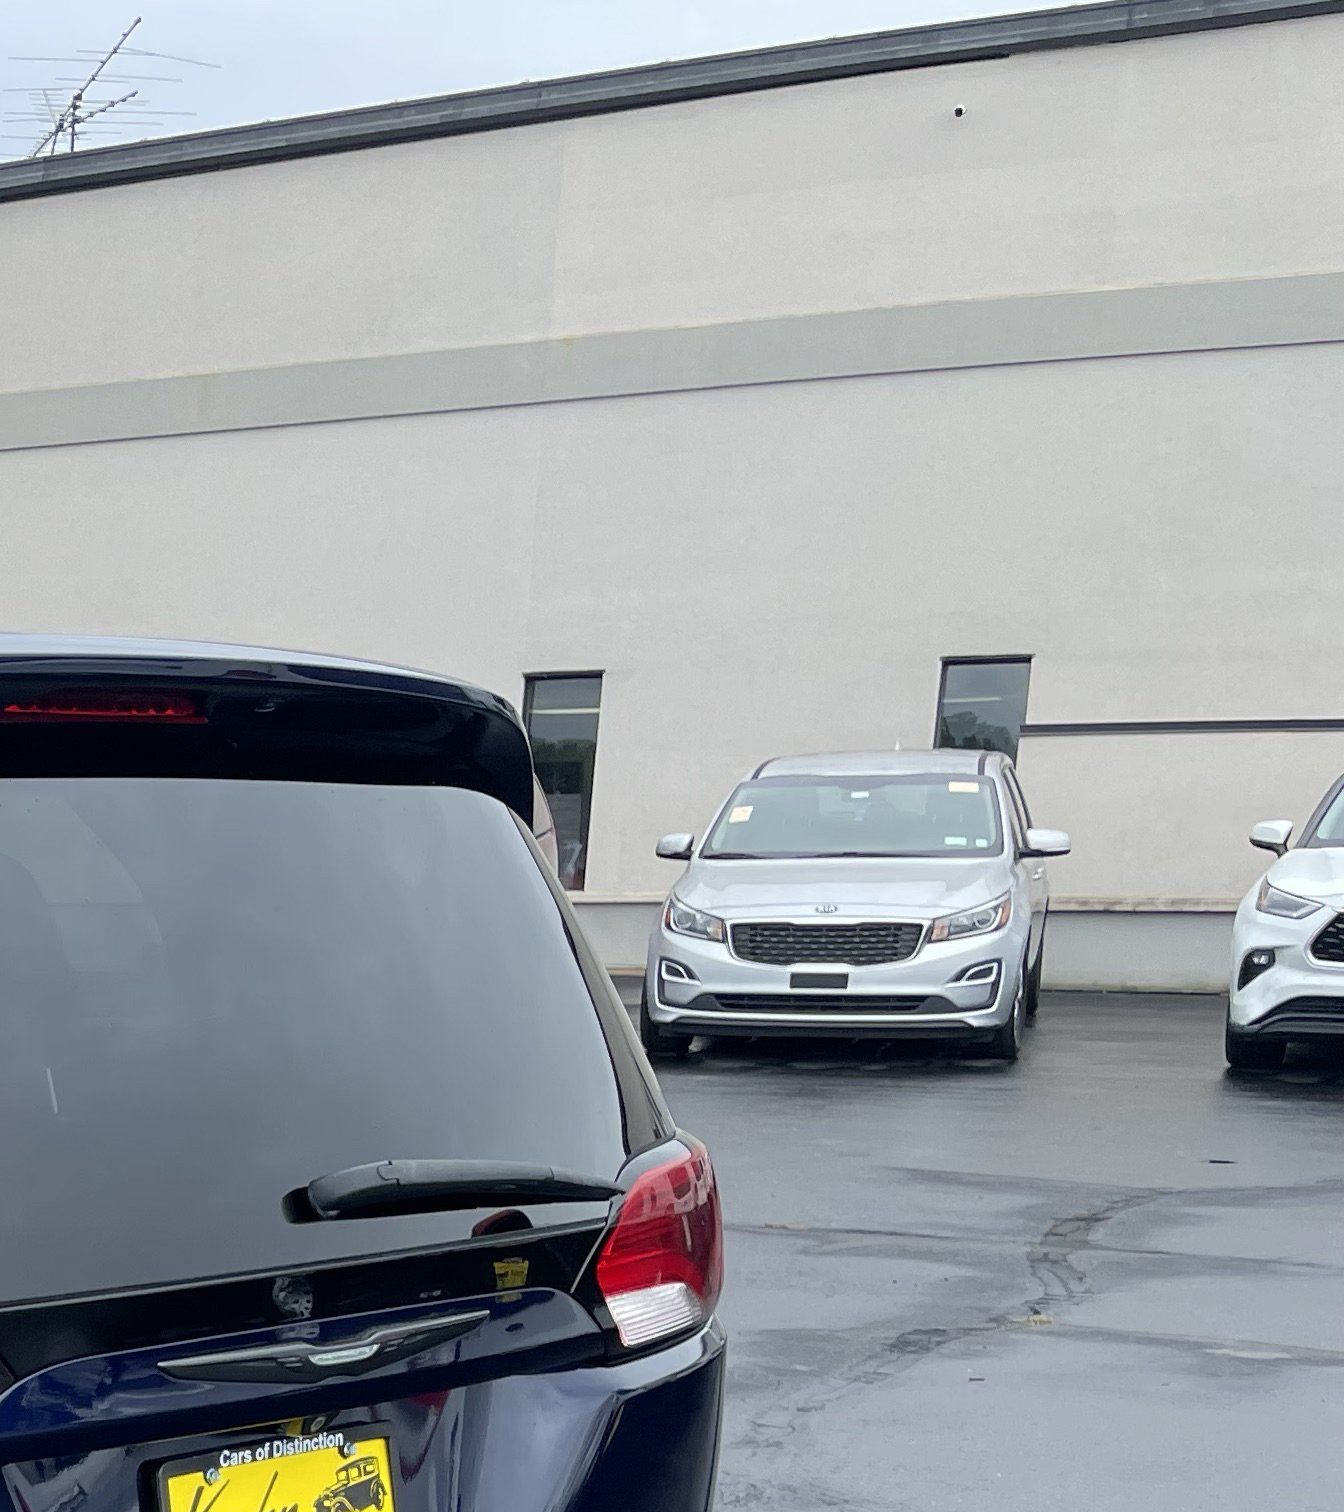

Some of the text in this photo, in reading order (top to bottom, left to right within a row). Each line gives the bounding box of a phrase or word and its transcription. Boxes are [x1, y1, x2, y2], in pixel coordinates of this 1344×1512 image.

[219, 1431, 345, 1468] Cars of Distinction
